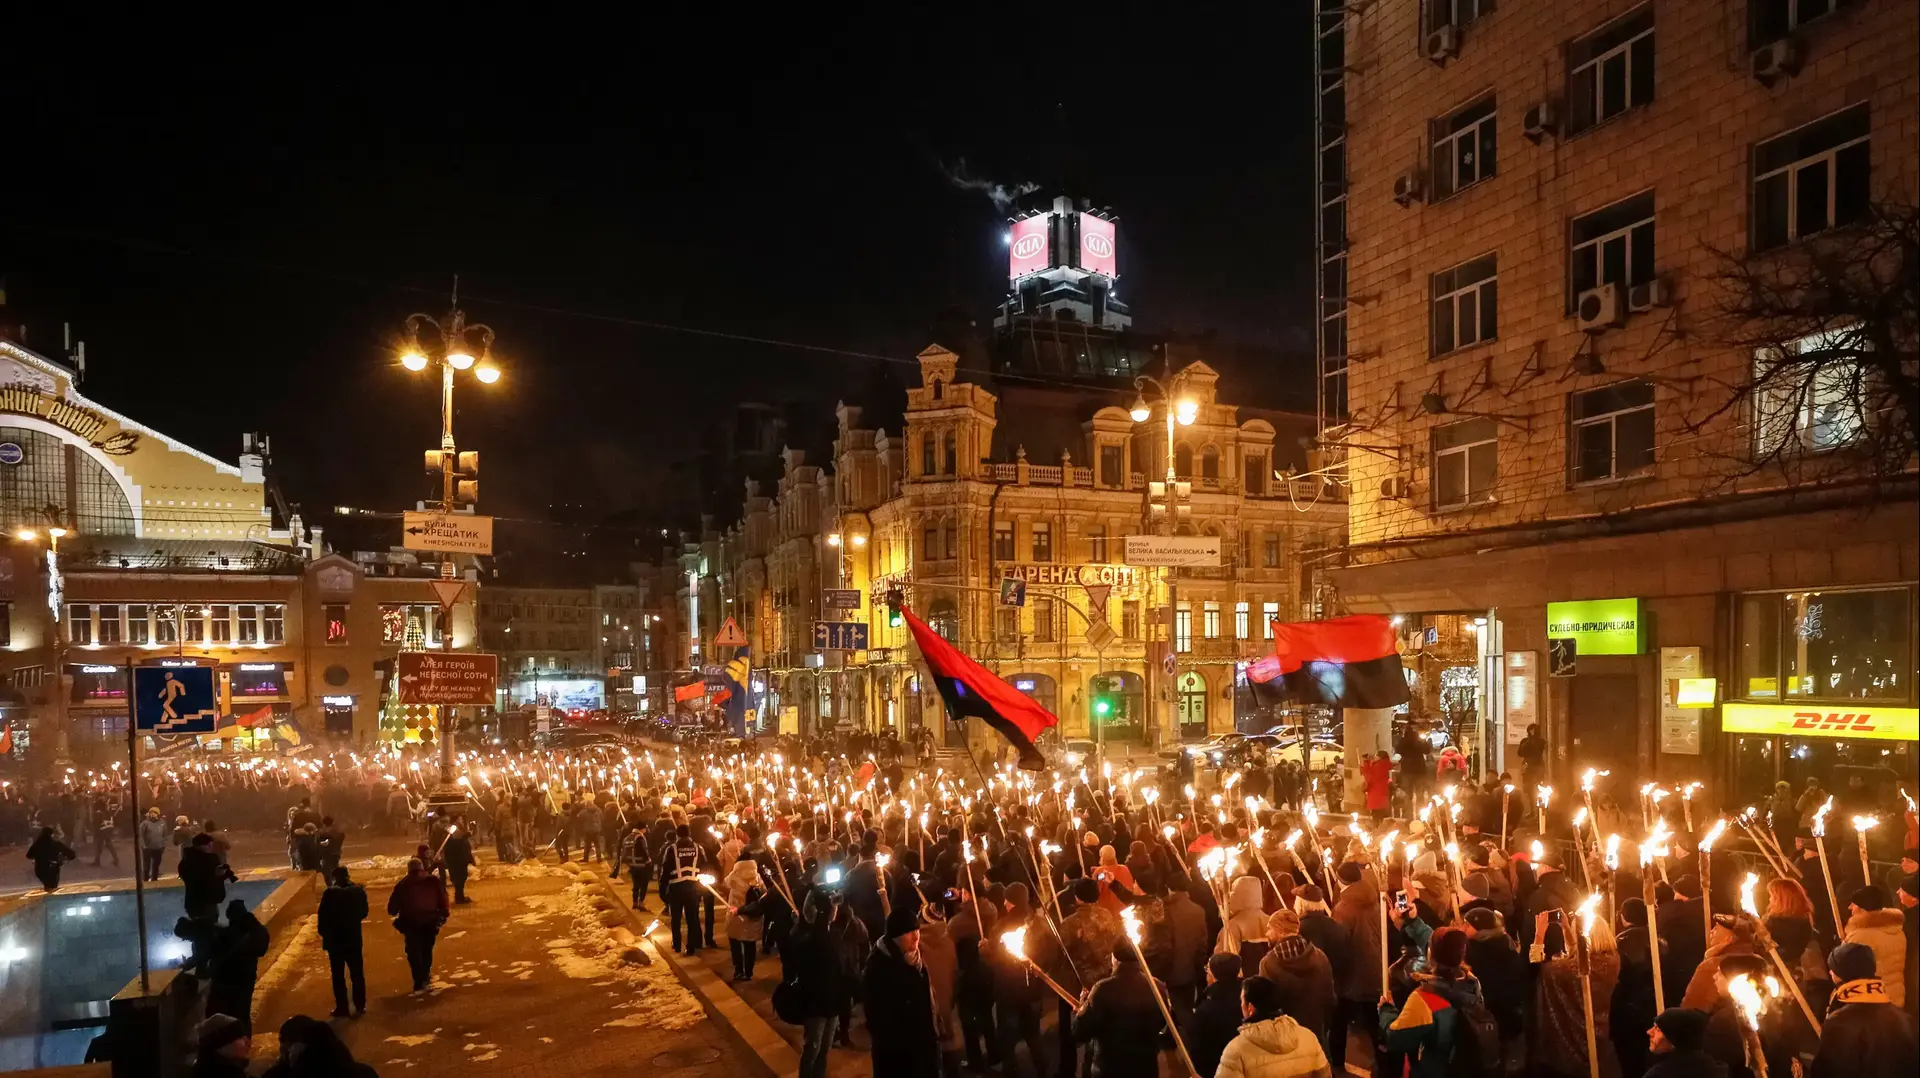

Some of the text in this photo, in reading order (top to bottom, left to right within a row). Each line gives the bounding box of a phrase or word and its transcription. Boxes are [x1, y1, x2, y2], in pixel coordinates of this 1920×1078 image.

[1018, 238, 1040, 255] KIA
[1088, 236, 1107, 254] KIA
[424, 528, 479, 539] ХРЕЩАТИК
[1013, 566, 1077, 584] АРЕНА
[1550, 621, 1635, 633] СУДЕБНО-ЮРИДИЧЕСКАЯ
[446, 661, 475, 670] ГЕРОЇВ
[420, 671, 461, 679] НЕБЕСНОЇ
[1792, 712, 1876, 732] DHL
